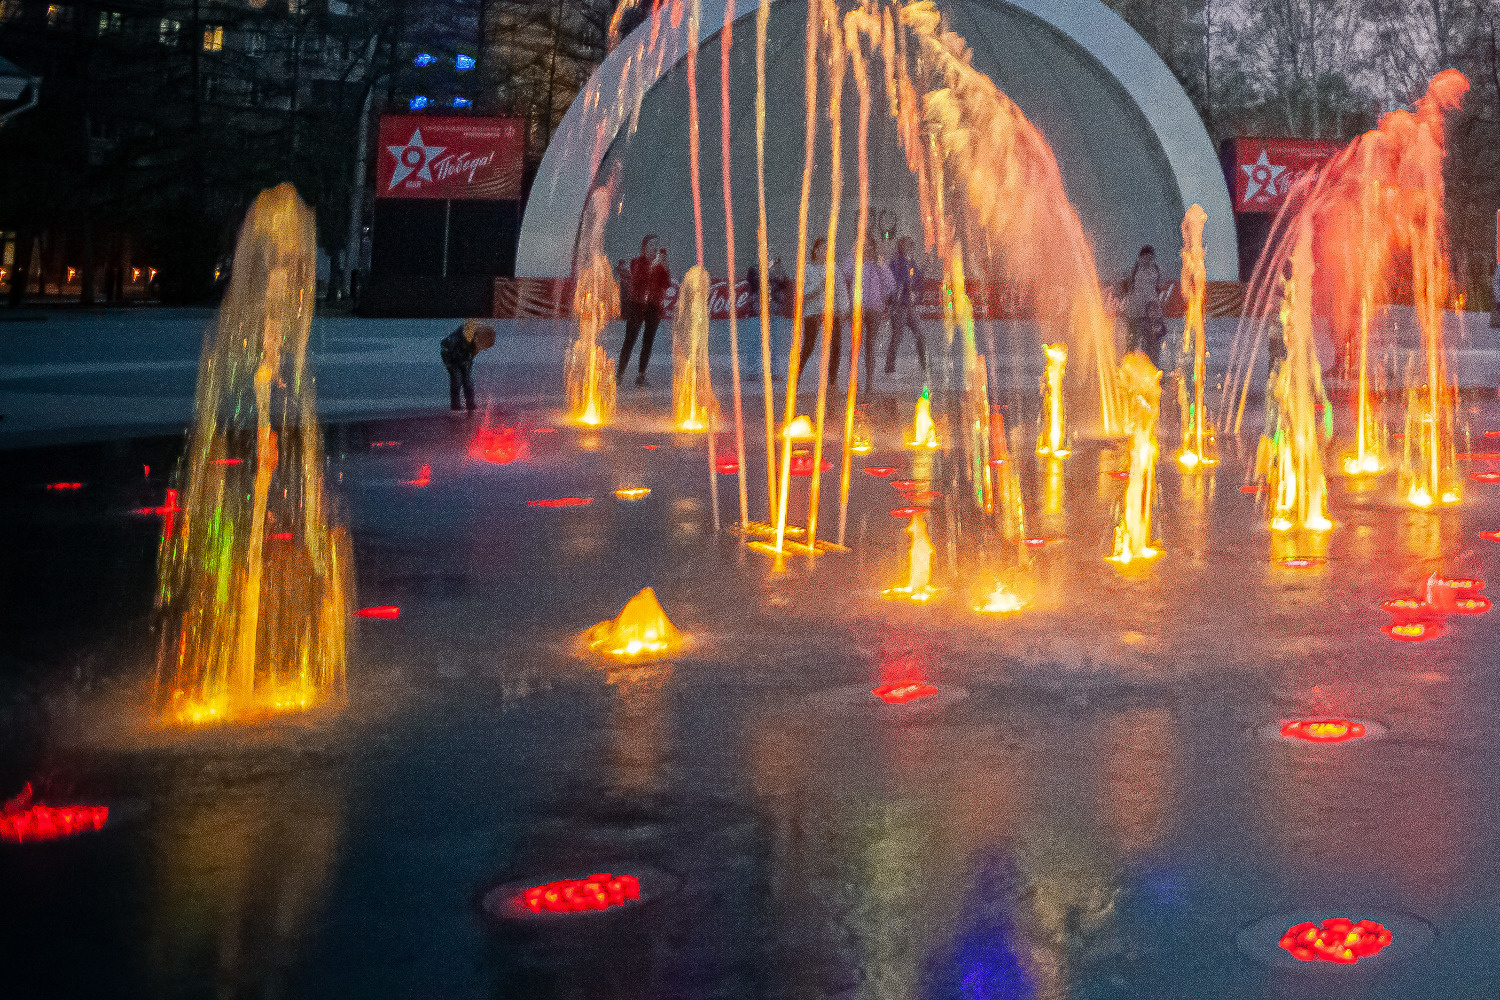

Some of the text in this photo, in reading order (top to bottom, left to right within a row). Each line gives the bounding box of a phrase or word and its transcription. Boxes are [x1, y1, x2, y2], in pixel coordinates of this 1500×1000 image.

[401, 146, 426, 182] 9
[434, 151, 495, 183] Победа!
[1252, 165, 1272, 192] 9
